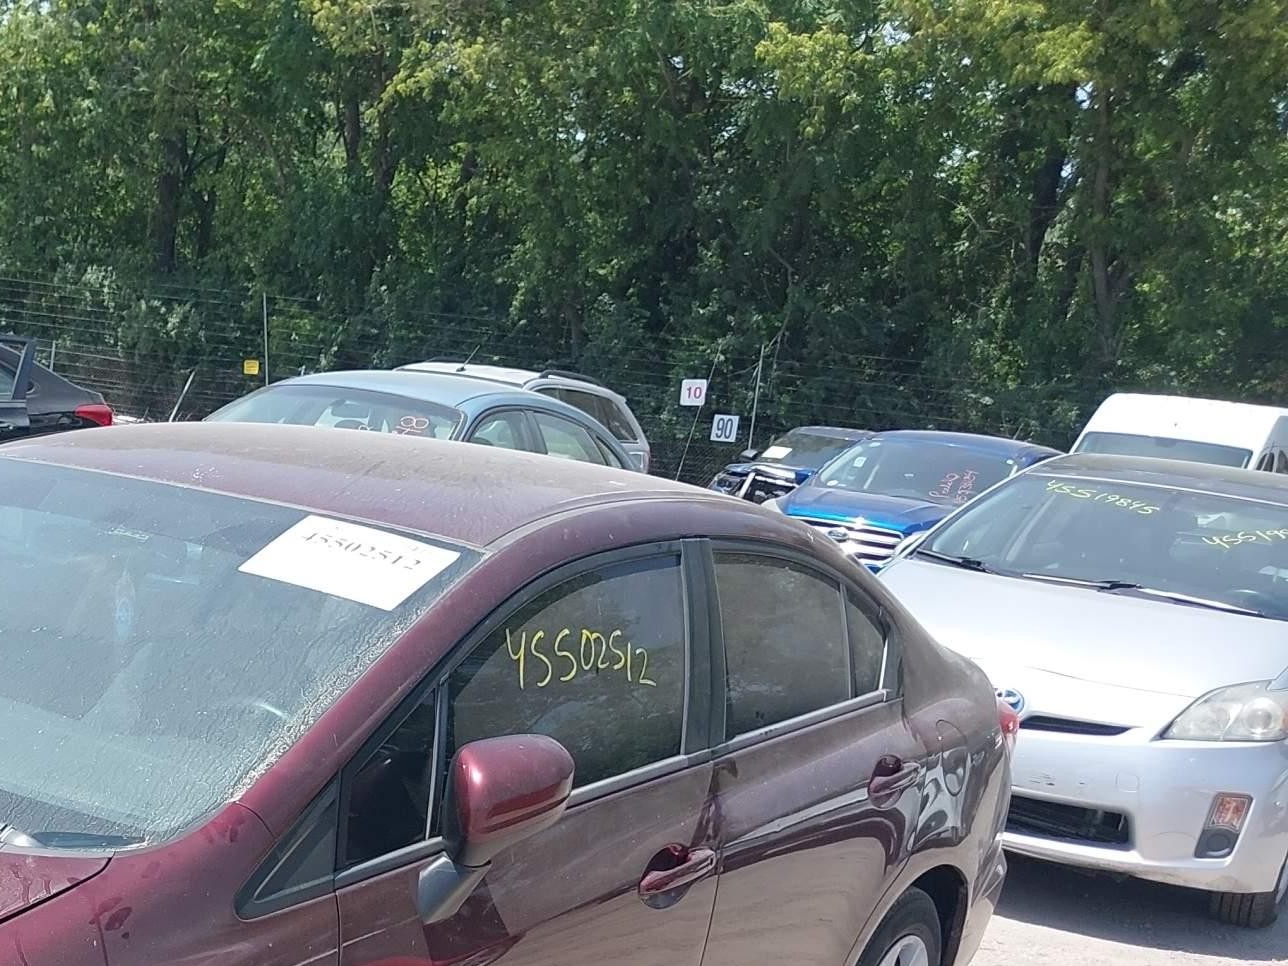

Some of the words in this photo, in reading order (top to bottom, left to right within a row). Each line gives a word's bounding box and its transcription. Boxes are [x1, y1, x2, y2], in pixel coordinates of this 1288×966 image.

[686, 386, 702, 399] 10
[715, 417, 734, 440] 90
[1046, 479, 1160, 514] 45519845
[505, 627, 657, 691] 45502512
